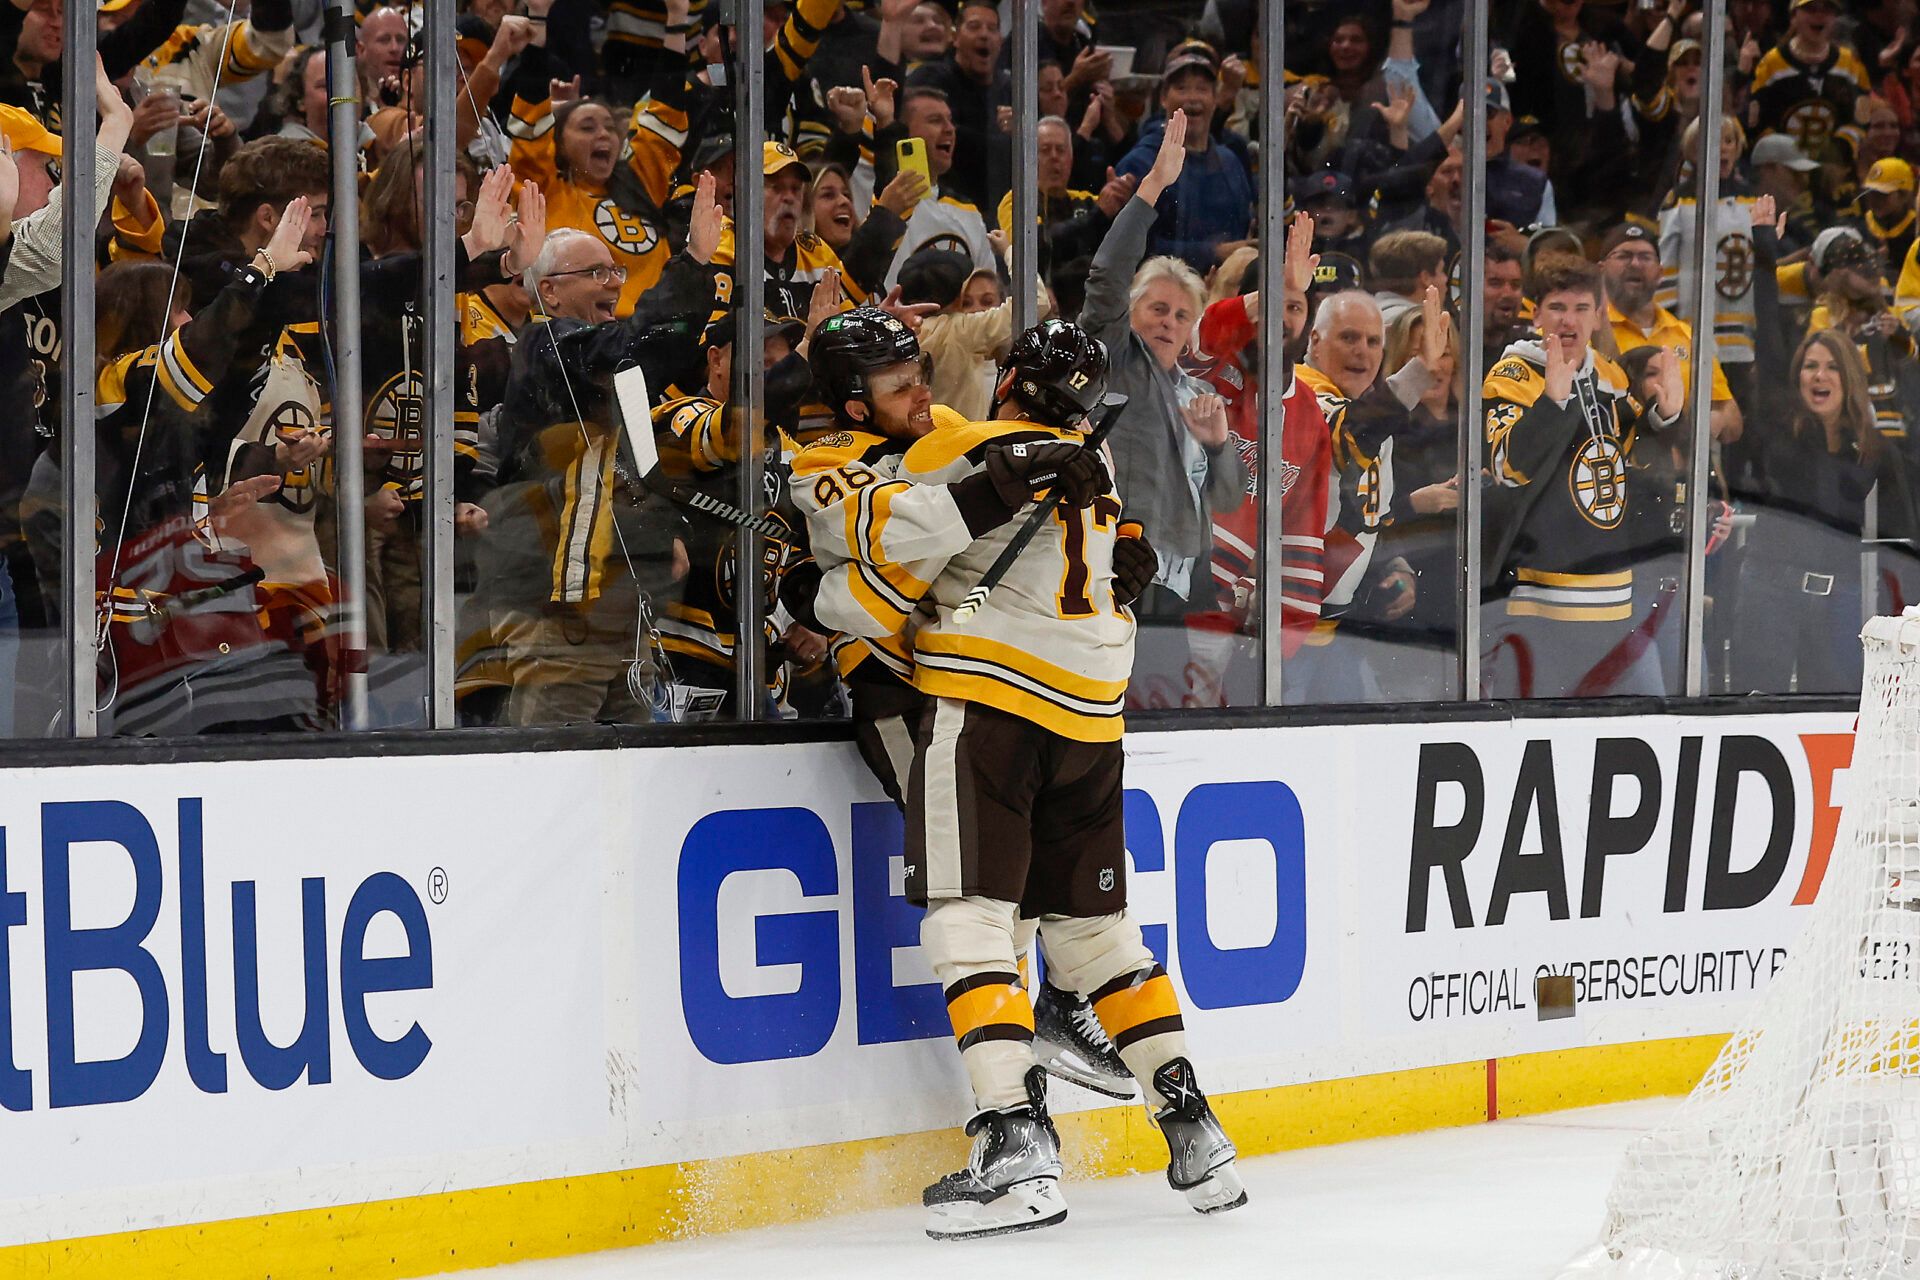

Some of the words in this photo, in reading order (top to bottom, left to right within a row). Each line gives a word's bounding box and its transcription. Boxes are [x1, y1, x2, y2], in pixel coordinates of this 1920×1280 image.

[1068, 370, 1089, 391] 17
[677, 780, 1307, 1065] GEO
[1408, 967, 1526, 1022] OFFICIAL
[1533, 948, 1765, 1004] BERSECURITY
